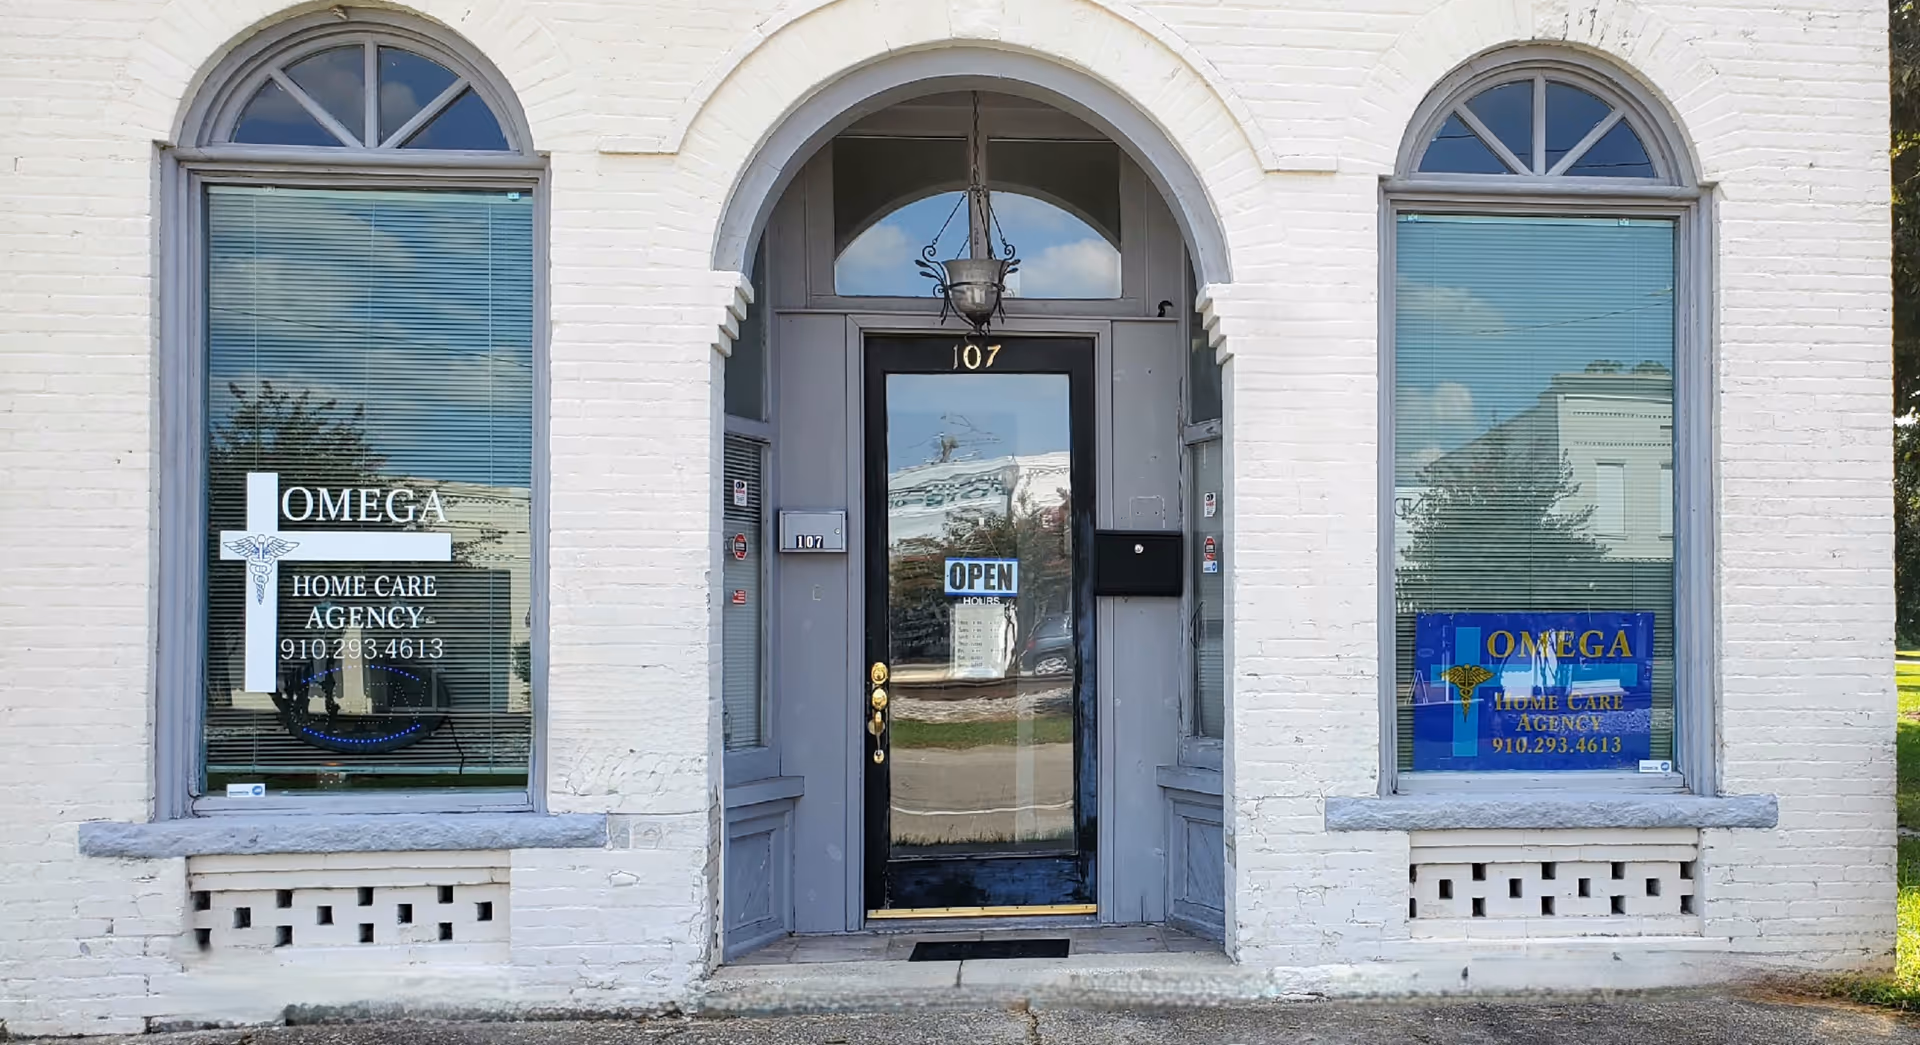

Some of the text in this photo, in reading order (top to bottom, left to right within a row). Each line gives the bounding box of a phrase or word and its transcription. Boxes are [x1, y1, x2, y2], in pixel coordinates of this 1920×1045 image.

[953, 344, 1002, 370] 107
[282, 487, 447, 523] OMEGA
[797, 535, 823, 548] 107
[292, 575, 437, 597] HOME CARE
[949, 562, 1013, 591] OPEN
[963, 597, 1001, 605] HOURS
[304, 606, 425, 629] AGENCY
[280, 638, 444, 660] 910.293.4613
[1486, 629, 1633, 658] OMEGA
[1494, 692, 1624, 711] HOME CARE
[1515, 713, 1603, 732] AGENCY
[1492, 737, 1622, 754] 910.293.4613
